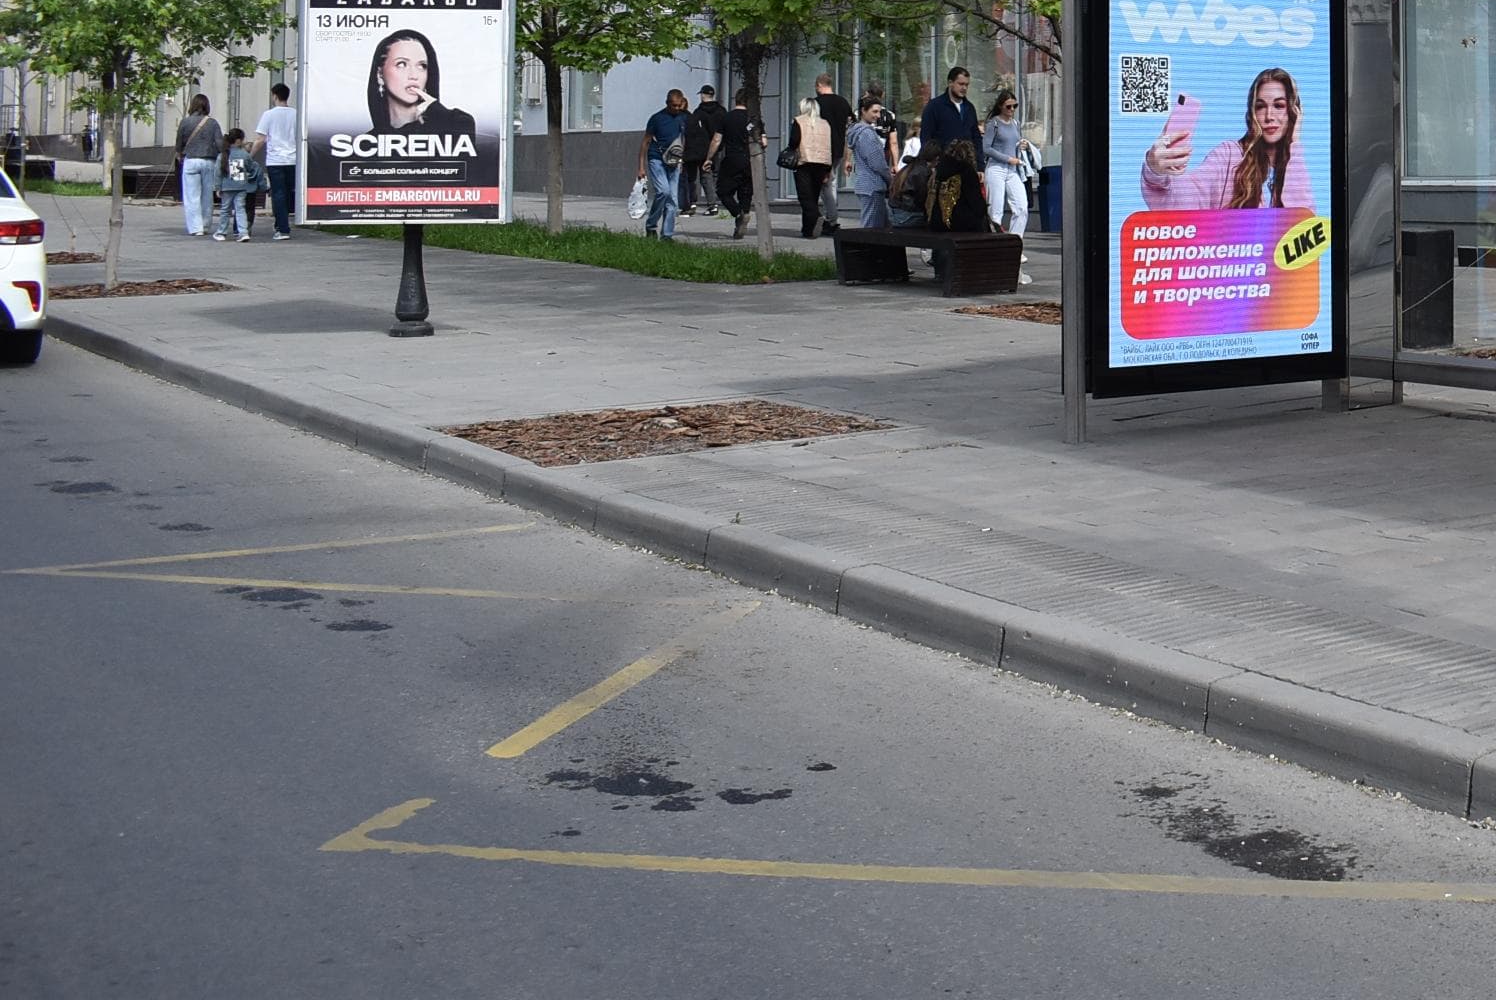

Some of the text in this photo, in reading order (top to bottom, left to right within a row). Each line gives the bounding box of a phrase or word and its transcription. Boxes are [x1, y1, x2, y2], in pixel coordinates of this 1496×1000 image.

[316, 14, 389, 28] 13 ИЮНЯ
[330, 133, 478, 158] SCIRENA
[326, 189, 481, 202] БИЛЕТЫ: EMBARGOVILLA.RU
[1132, 224, 1197, 241] новое
[1282, 222, 1326, 264] LIKE
[1132, 243, 1264, 267] приложение
[1132, 262, 1267, 286] для шопинга
[1133, 283, 1271, 306] и творчества
[1301, 332, 1319, 341] СОФА
[1301, 341, 1320, 351] КУПЕР
